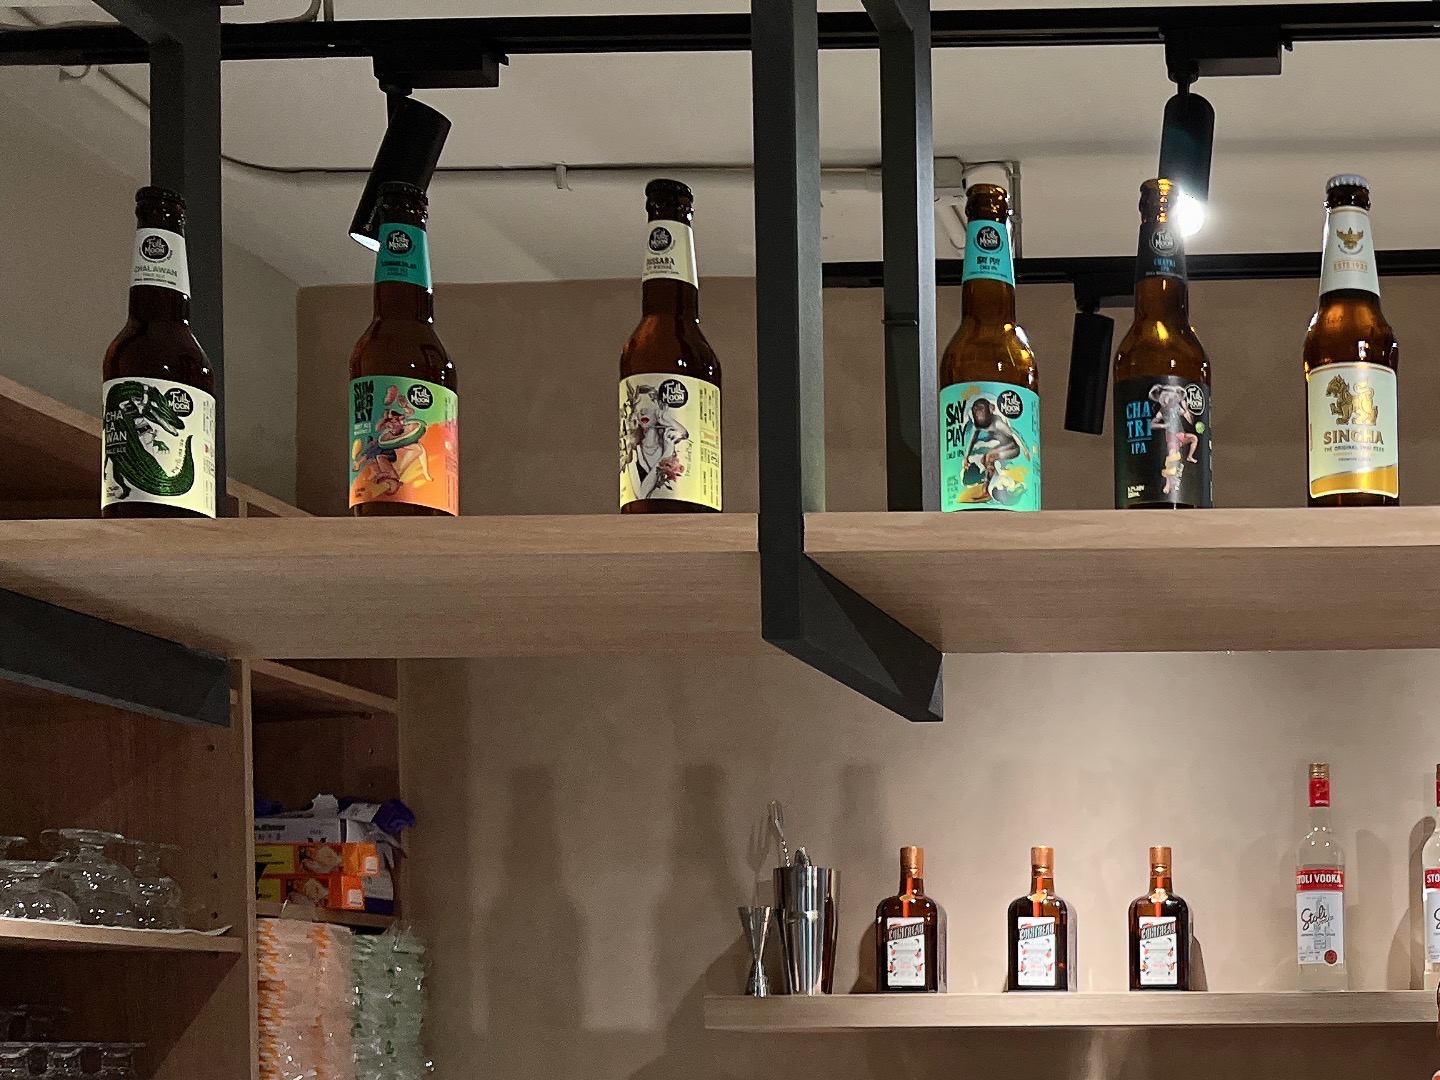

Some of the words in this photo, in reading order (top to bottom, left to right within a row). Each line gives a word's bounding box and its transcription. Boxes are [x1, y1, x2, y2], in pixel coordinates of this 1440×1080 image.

[106, 409, 123, 423] CHA
[946, 399, 966, 427] SAY
[1126, 400, 1152, 420] CHA
[106, 422, 115, 433] LA
[1126, 419, 1152, 439] TRI
[106, 431, 127, 443] WAN
[946, 424, 966, 452] PLAY
[1323, 429, 1384, 445] SINGHA
[1130, 441, 1147, 455] IPA
[1314, 873, 1341, 884] VODKA
[1141, 921, 1176, 940] COINTREAU
